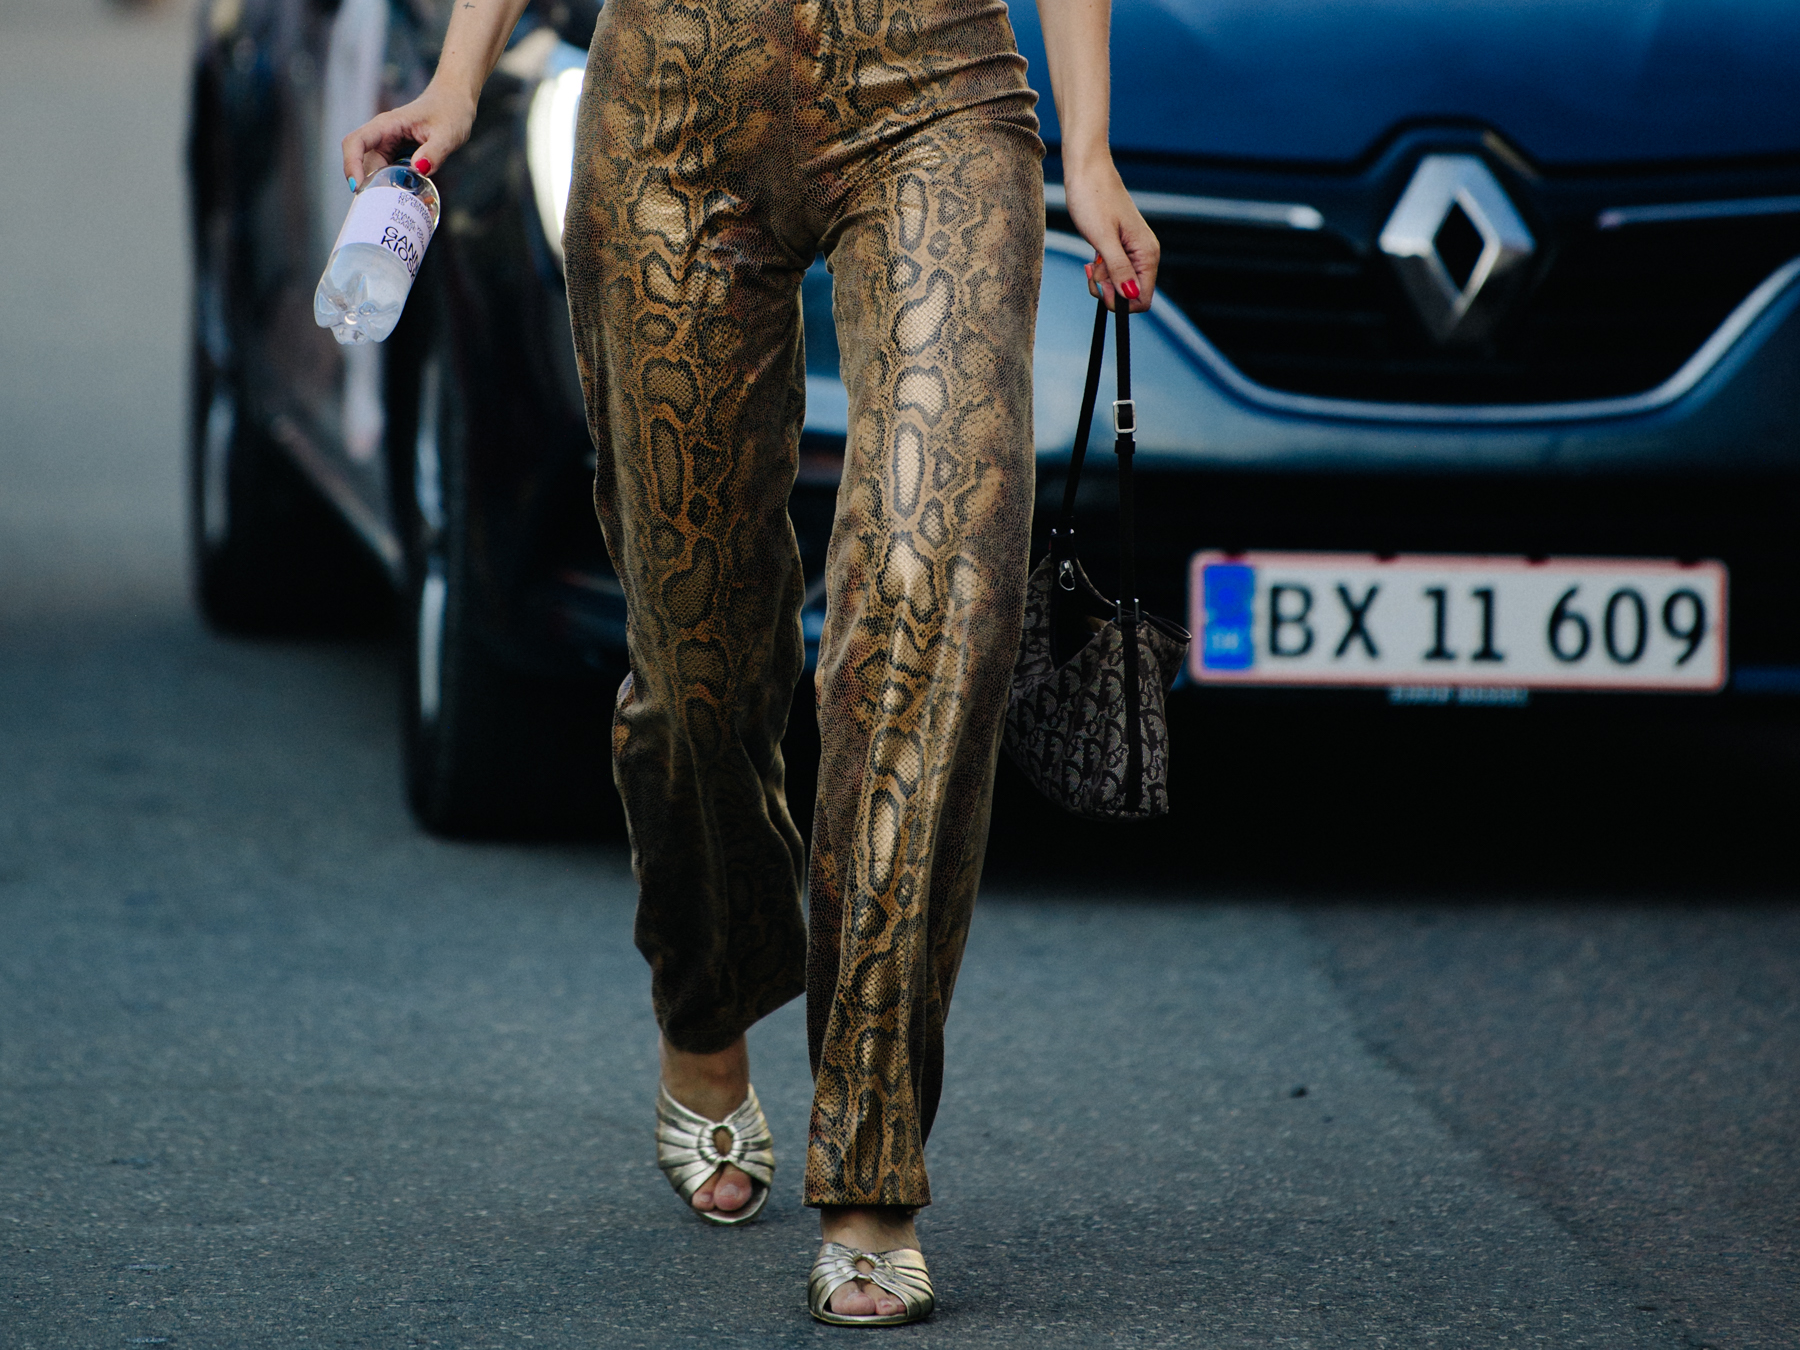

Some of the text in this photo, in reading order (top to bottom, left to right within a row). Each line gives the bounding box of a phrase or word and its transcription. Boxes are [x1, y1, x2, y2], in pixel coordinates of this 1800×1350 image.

[385, 226, 419, 268] GANN
[1267, 583, 1708, 666] BX 11 609
